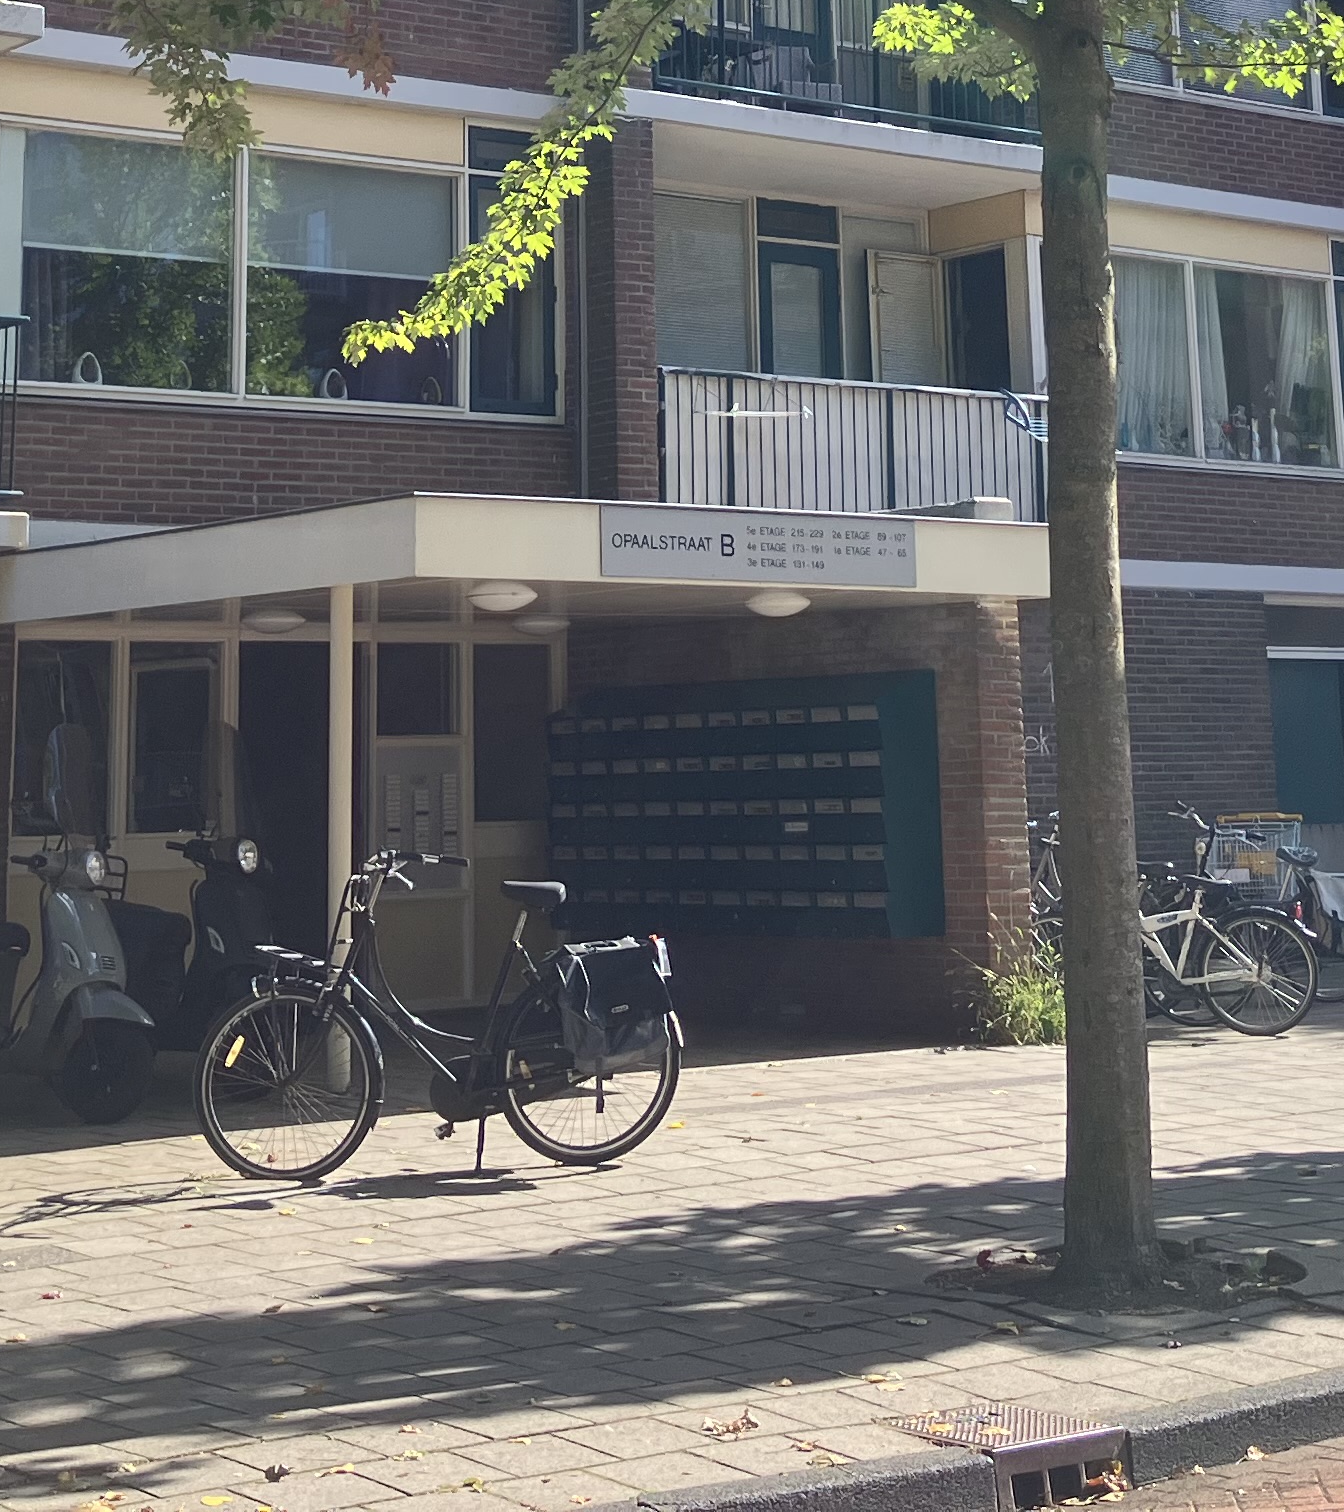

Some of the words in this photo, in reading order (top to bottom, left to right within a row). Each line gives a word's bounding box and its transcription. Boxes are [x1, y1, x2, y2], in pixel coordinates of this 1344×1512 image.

[759, 526, 786, 537] ETAGE
[845, 530, 871, 541] ETAGE
[611, 532, 713, 552] OPAALSTRAAT
[720, 534, 735, 557] B
[760, 542, 787, 552] ETAGE
[845, 546, 871, 556] ETAGE
[760, 558, 787, 568] ETAGE
